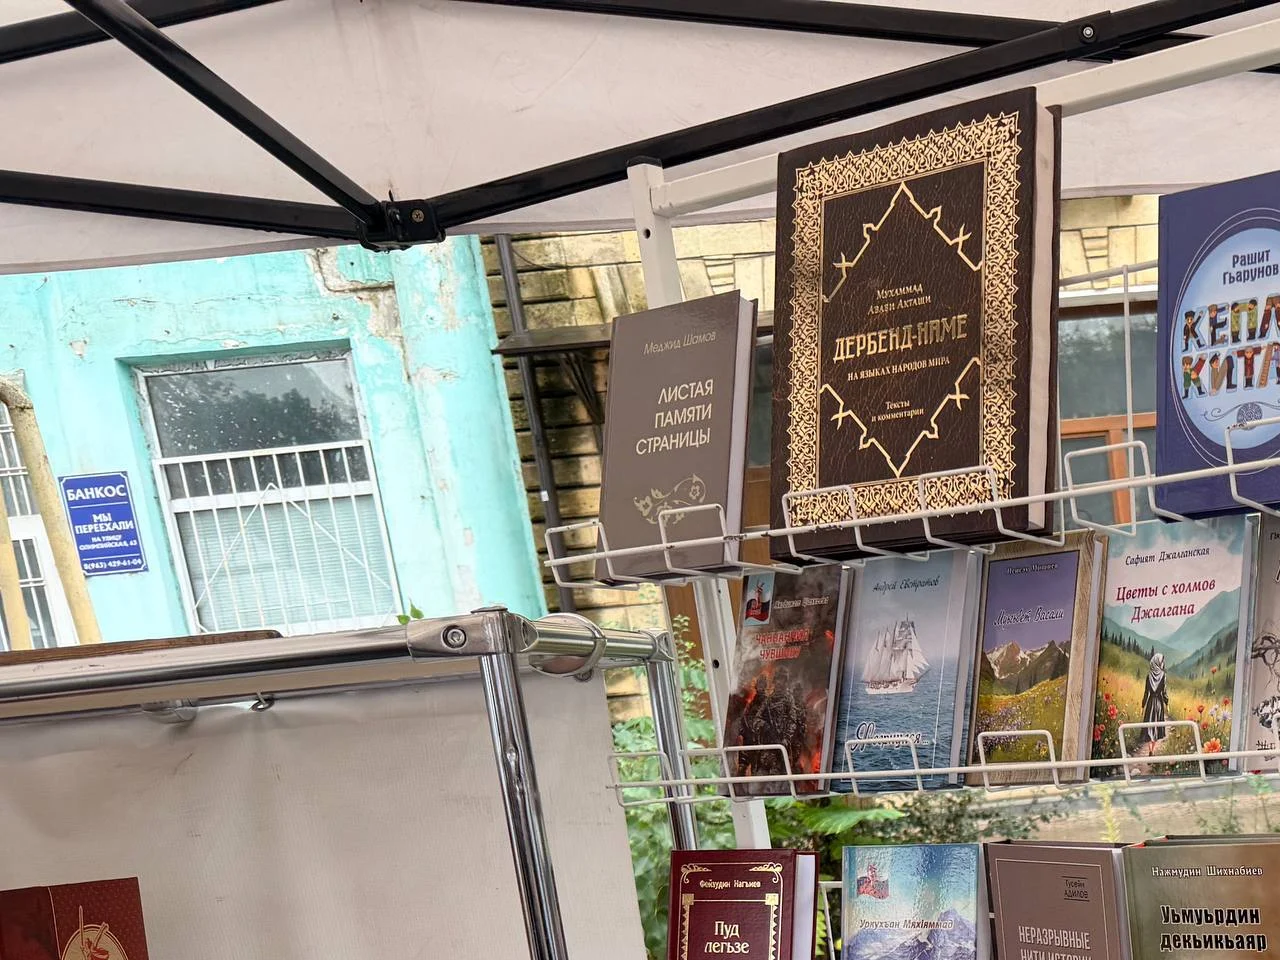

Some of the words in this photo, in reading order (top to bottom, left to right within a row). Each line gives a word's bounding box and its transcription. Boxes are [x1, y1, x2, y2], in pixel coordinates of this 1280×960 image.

[1232, 250, 1271, 268] Рашит
[1222, 263, 1279, 285] Гьарунов
[643, 339, 681, 355] Меджид
[683, 331, 717, 347] Шамов
[833, 313, 968, 364] ДЕРБЕНД-НАМЕ
[847, 372, 859, 381] НА
[860, 367, 891, 381] ЯЗЫКАХ
[892, 361, 927, 374] НАРОДОВ
[928, 356, 950, 368] МИРА
[658, 379, 714, 405] ЛИСТАЯ
[655, 403, 712, 429] ПАМЯТИ
[877, 408, 924, 422] комментарии
[885, 400, 910, 411] Тексты
[635, 427, 711, 455] СТРАНИЦЫ
[66, 484, 127, 501] БАНКОС
[75, 520, 134, 534] ПЕРЕЕХАЛИ
[92, 512, 112, 523] МЫ
[1125, 555, 1156, 568] Сафият
[1158, 546, 1210, 563] Джалганская
[1116, 585, 1158, 602] Цветы
[1161, 585, 1168, 595] с
[1171, 578, 1216, 594] холмов
[1131, 602, 1195, 623] Джалгана
[1151, 866, 1201, 878] Нажмудин
[1206, 865, 1263, 876] Шихнабиев
[1160, 905, 1261, 927] Уьмуьрдин
[714, 921, 739, 939] Пуд
[1018, 925, 1091, 950] НЕРАЗРЫВНЫЕ
